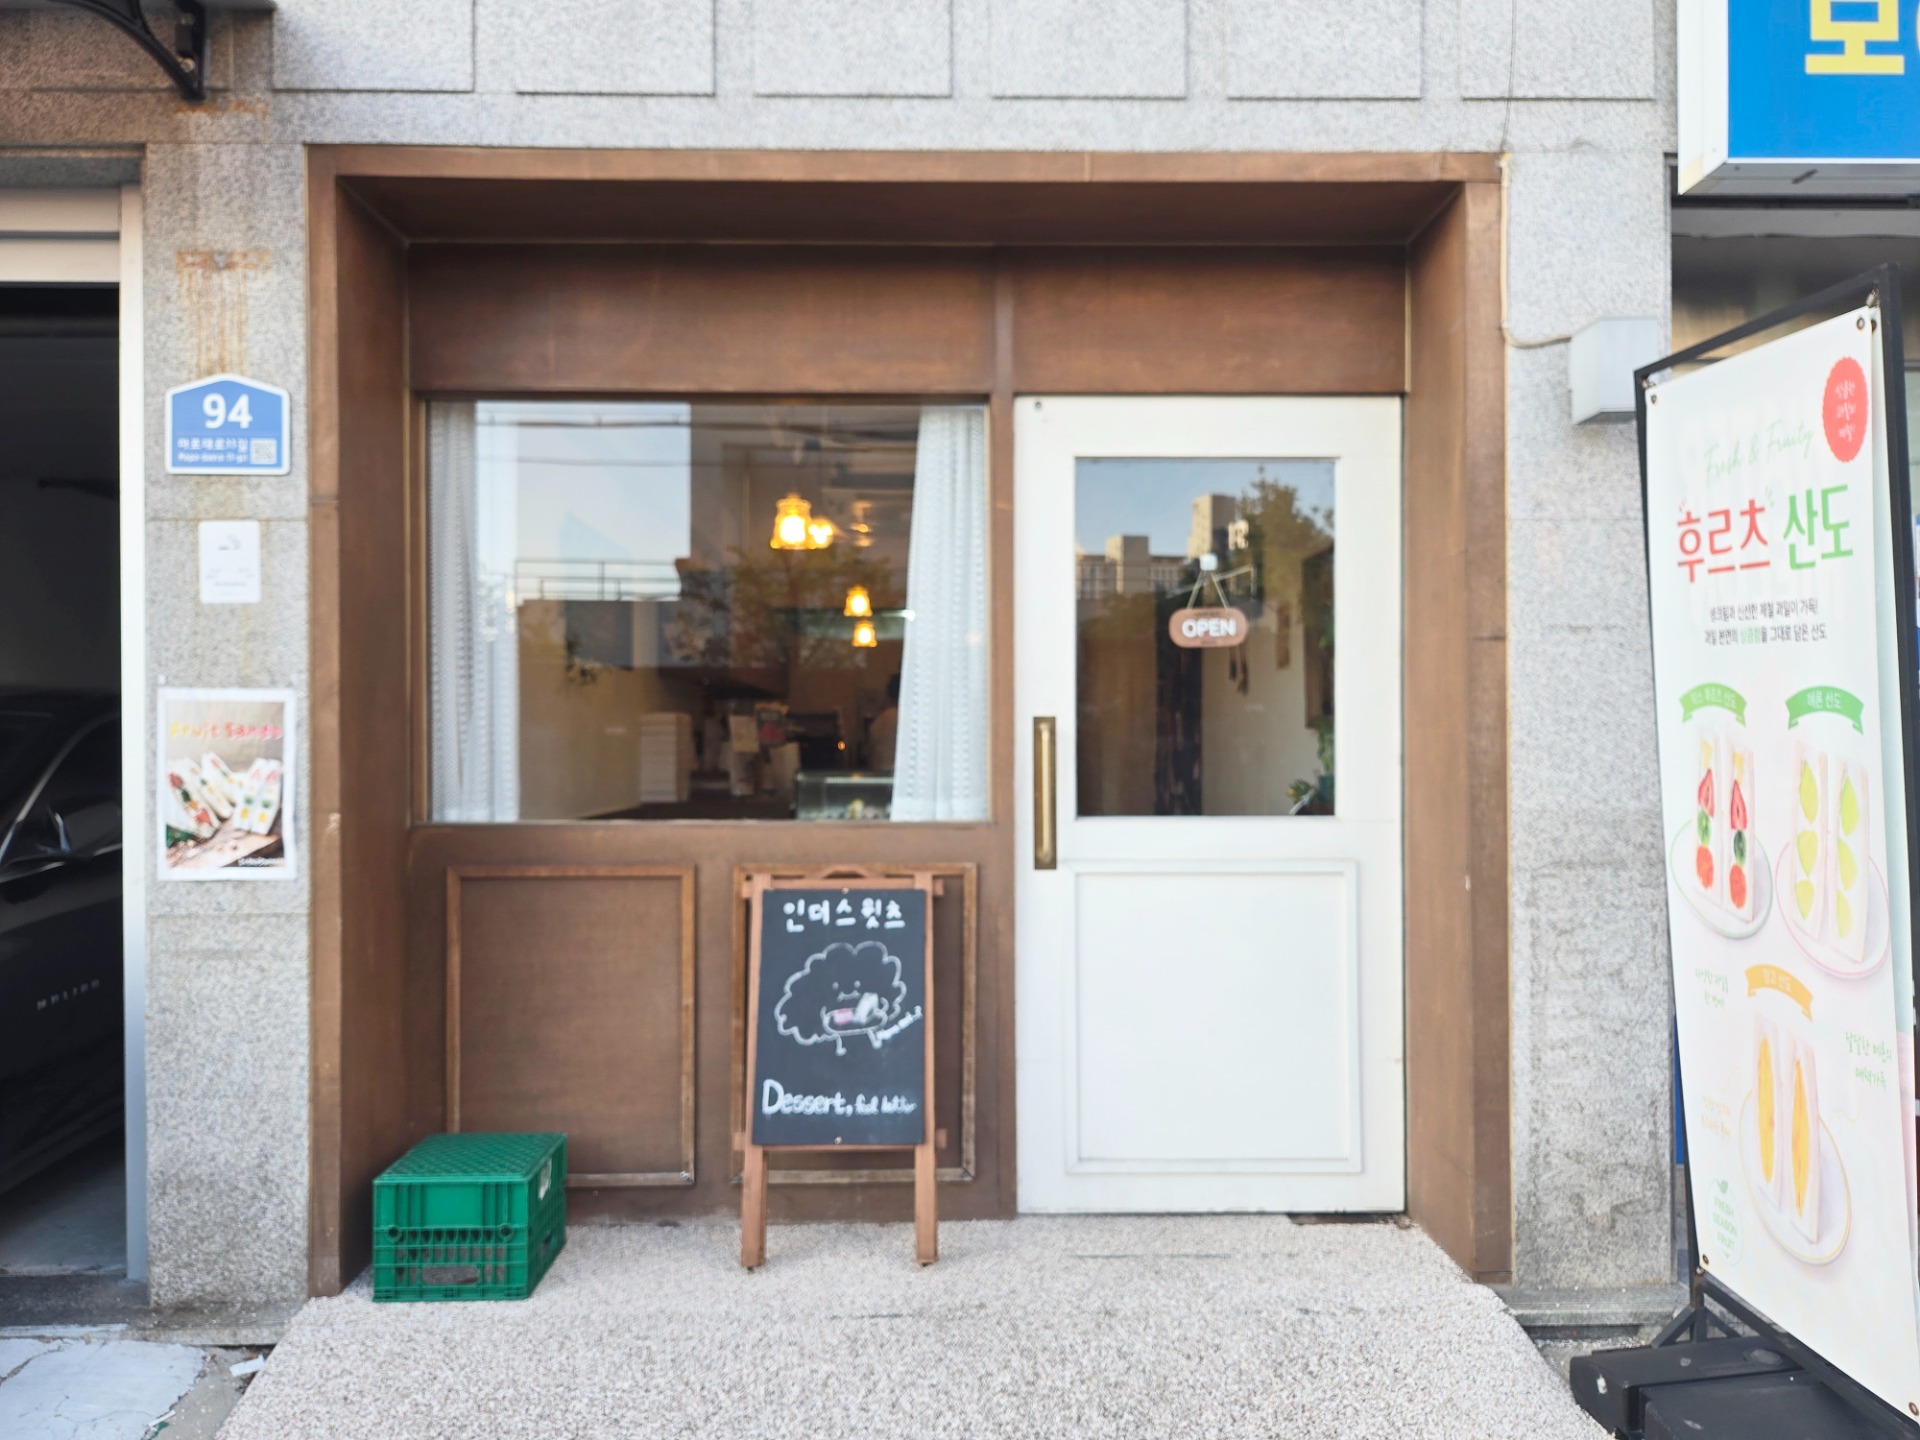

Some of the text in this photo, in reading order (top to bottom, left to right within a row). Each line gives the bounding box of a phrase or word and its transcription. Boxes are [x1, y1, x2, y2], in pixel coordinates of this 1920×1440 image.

[203, 393, 253, 429] 94
[1677, 484, 1853, 583] 후르츠 산도
[1182, 617, 1237, 638] OPEN
